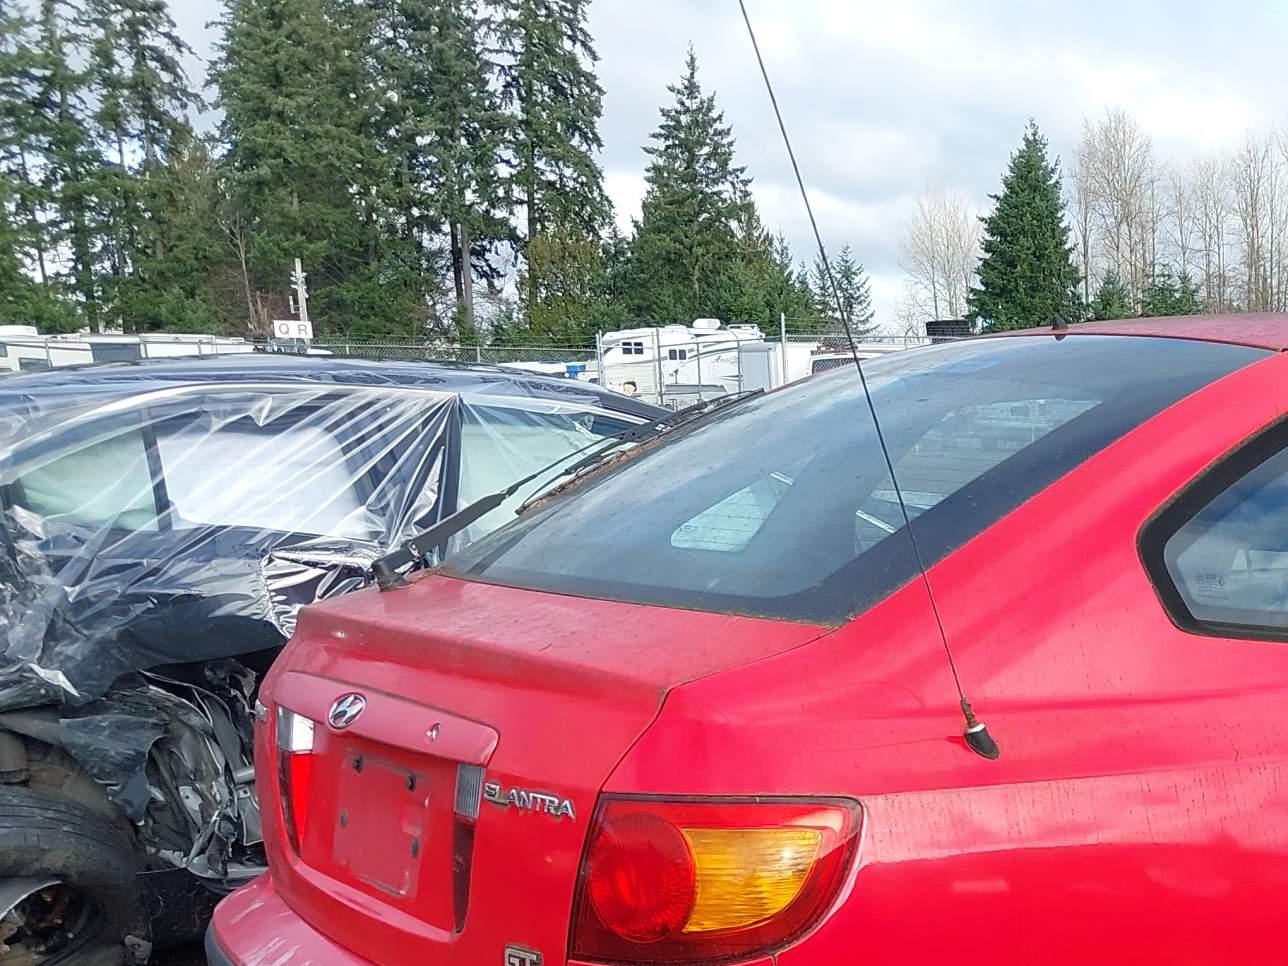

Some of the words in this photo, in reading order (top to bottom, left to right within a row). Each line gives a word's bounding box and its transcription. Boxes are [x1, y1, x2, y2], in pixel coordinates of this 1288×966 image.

[279, 323, 289, 335] Q
[298, 324, 308, 335] R
[485, 783, 575, 819] ELANTRA
